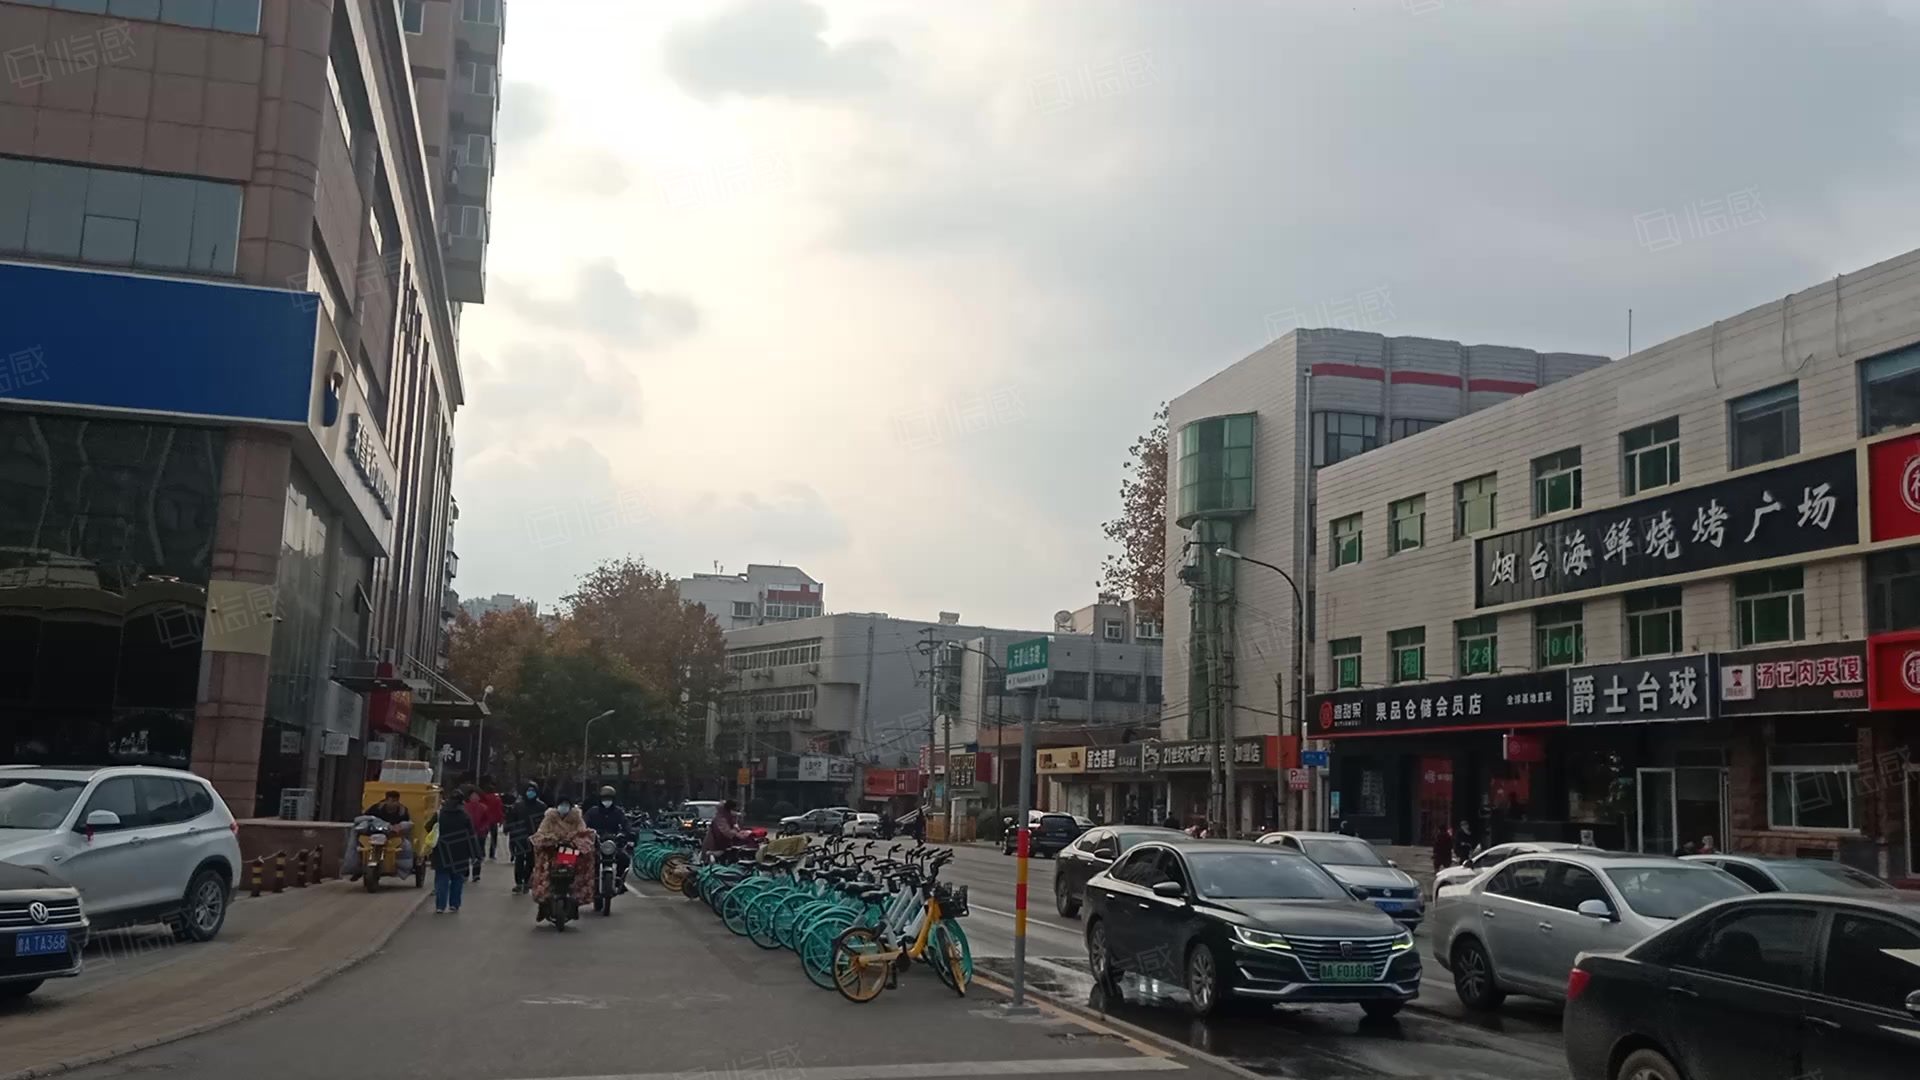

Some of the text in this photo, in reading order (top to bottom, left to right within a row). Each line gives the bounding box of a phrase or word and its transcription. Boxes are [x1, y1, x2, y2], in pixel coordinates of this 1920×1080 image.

[1489, 482, 1838, 588] 烟台海鲜烧烤广场
[1571, 666, 1698, 717] 爵士台球
[1756, 655, 1864, 689] 汤记肉夹馍
[1376, 692, 1483, 721] 果品仓储会员店
